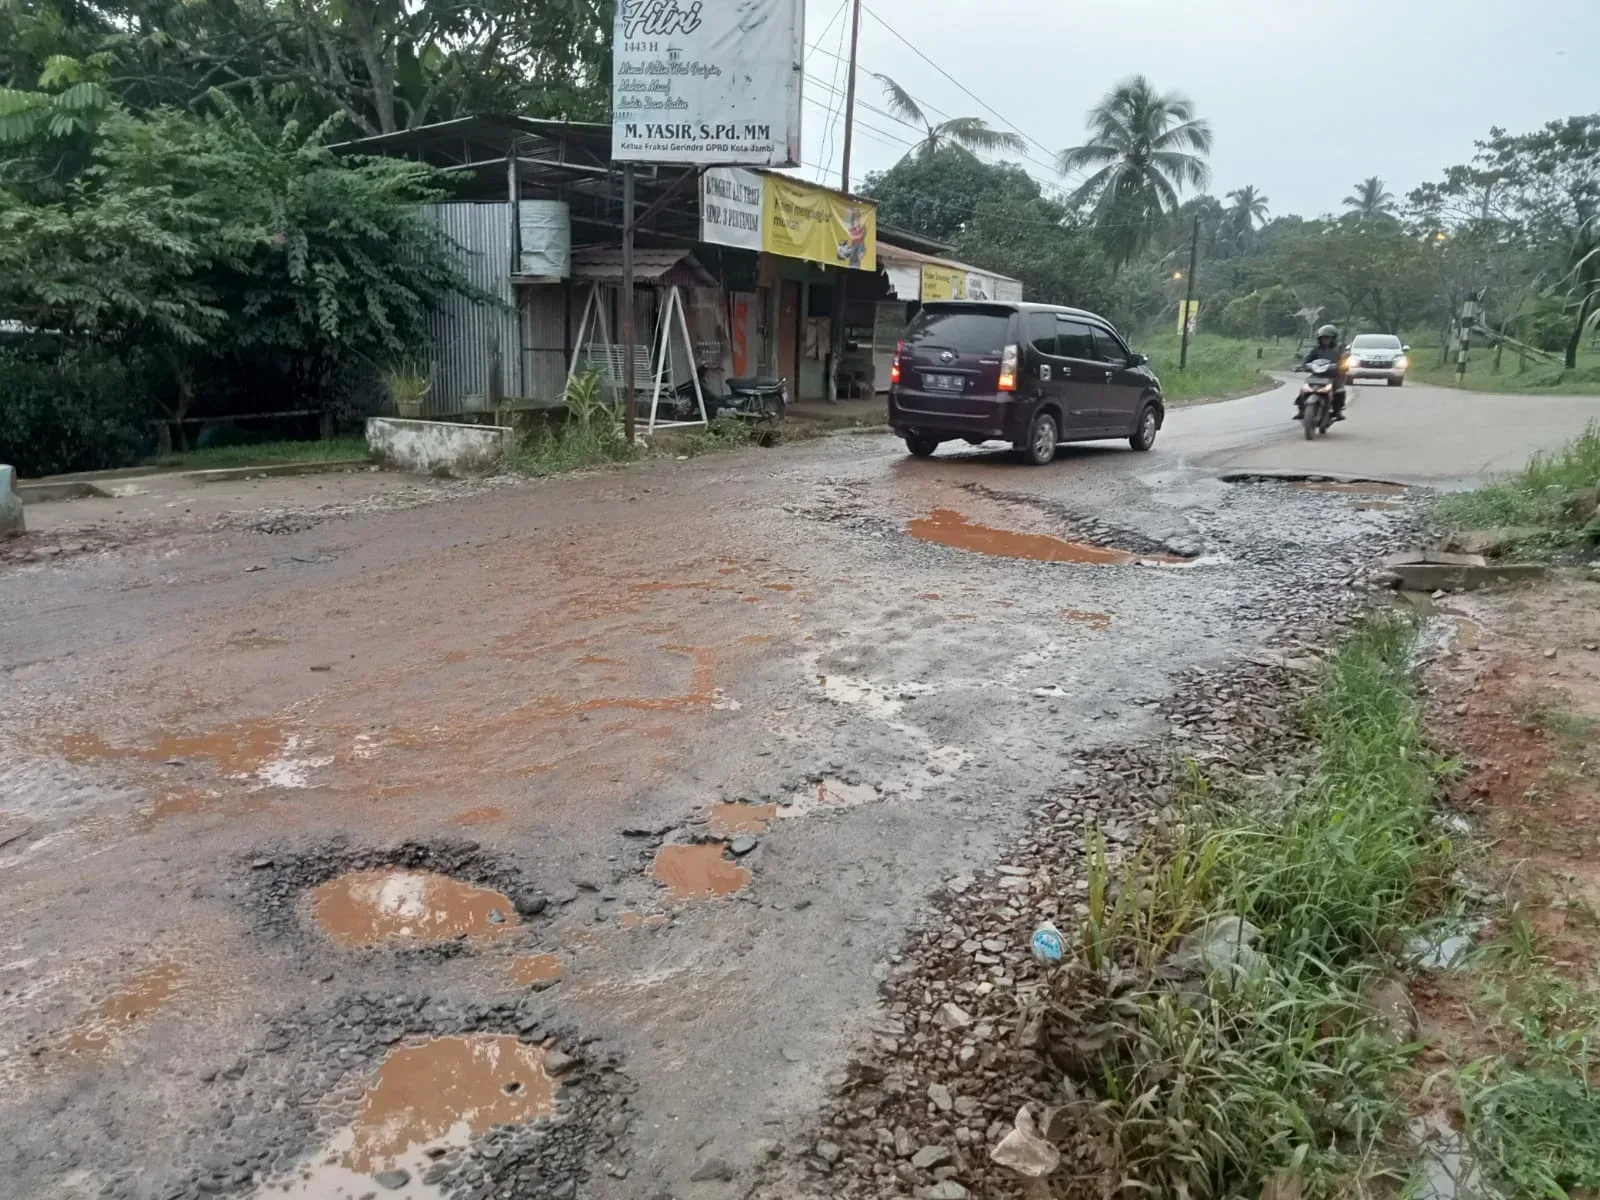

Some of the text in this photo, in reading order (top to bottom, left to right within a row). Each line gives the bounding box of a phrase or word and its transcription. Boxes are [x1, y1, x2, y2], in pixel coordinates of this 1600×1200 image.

[623, 0, 703, 39] Fitri
[624, 42, 658, 52] 1443 H
[625, 123, 770, 141] M. YASIR, S.Pd. MM
[621, 142, 775, 153] Ketua Fraksi Gerindra DPRD Kota Jambi
